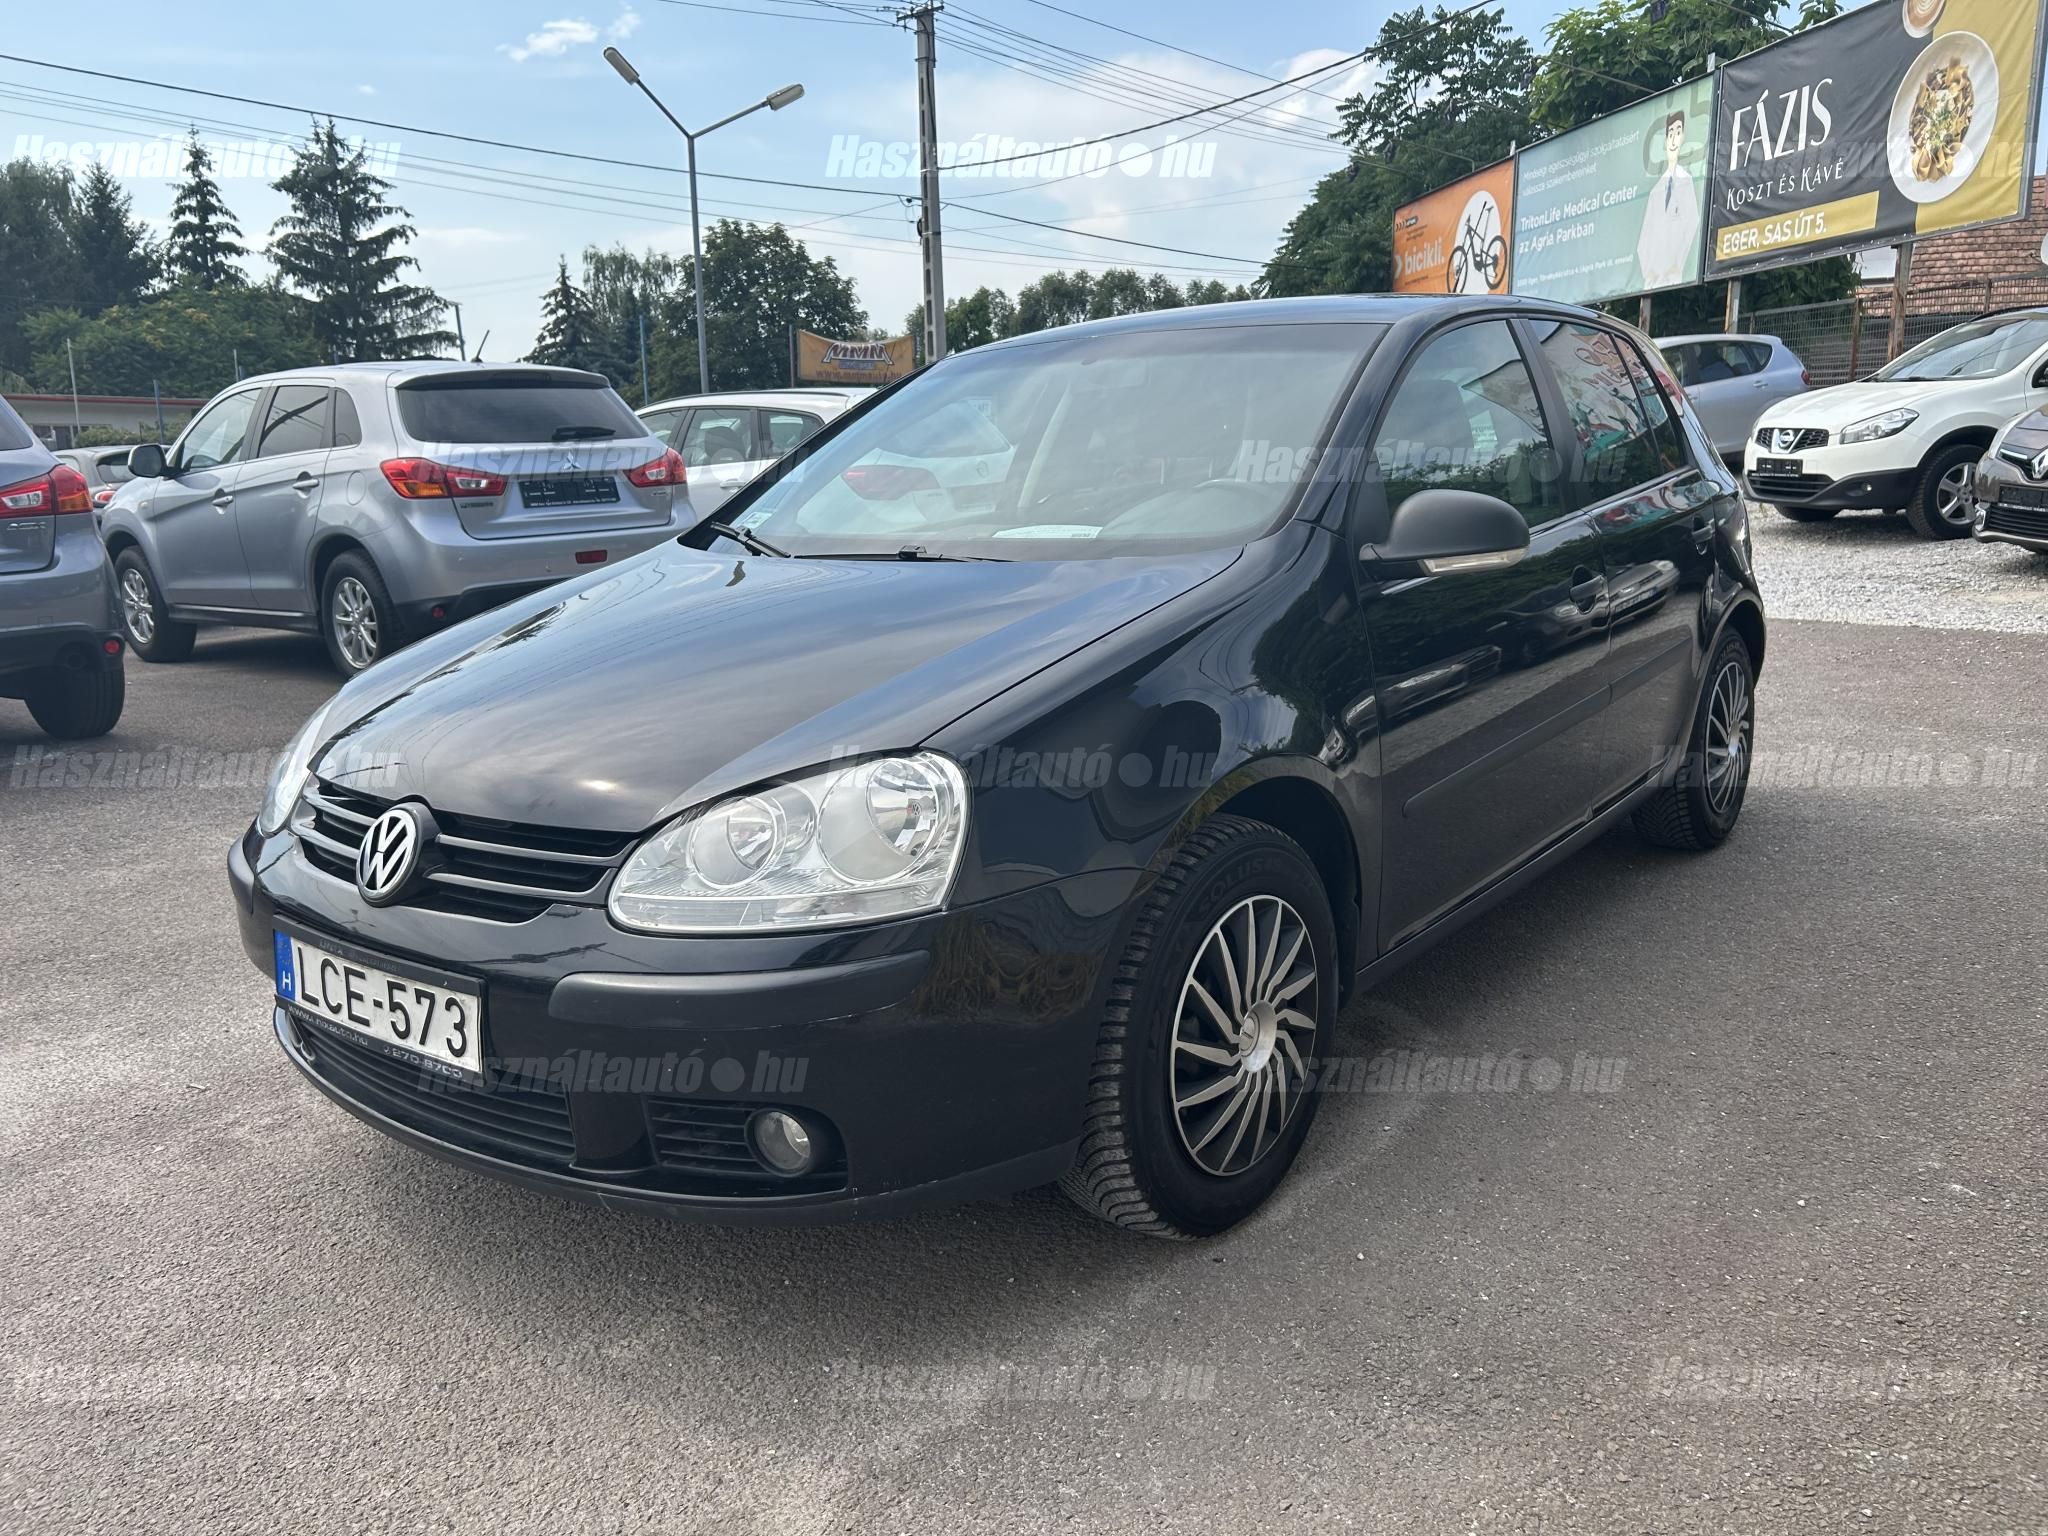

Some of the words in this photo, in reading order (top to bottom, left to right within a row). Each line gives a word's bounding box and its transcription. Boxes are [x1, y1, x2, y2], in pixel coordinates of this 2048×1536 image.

[1729, 78, 1833, 172] FÁZIS
[1726, 180, 1774, 211] KOSZT
[1778, 173, 1796, 194] ÉS
[1800, 157, 1845, 192] KÁVÉ
[1520, 207, 1561, 232] TritonLife
[1563, 193, 1600, 219] Medical
[1602, 185, 1638, 207] Center
[1518, 240, 1529, 254] az
[1530, 232, 1554, 252] Agria
[1556, 222, 1595, 244] Parkban
[1722, 227, 1760, 254] EGER,
[1762, 219, 1793, 245] SAS
[1794, 211, 1816, 236] ÚT
[1815, 211, 1827, 235] 5.
[282, 970, 292, 992] H
[298, 946, 468, 1058] LCE-573
